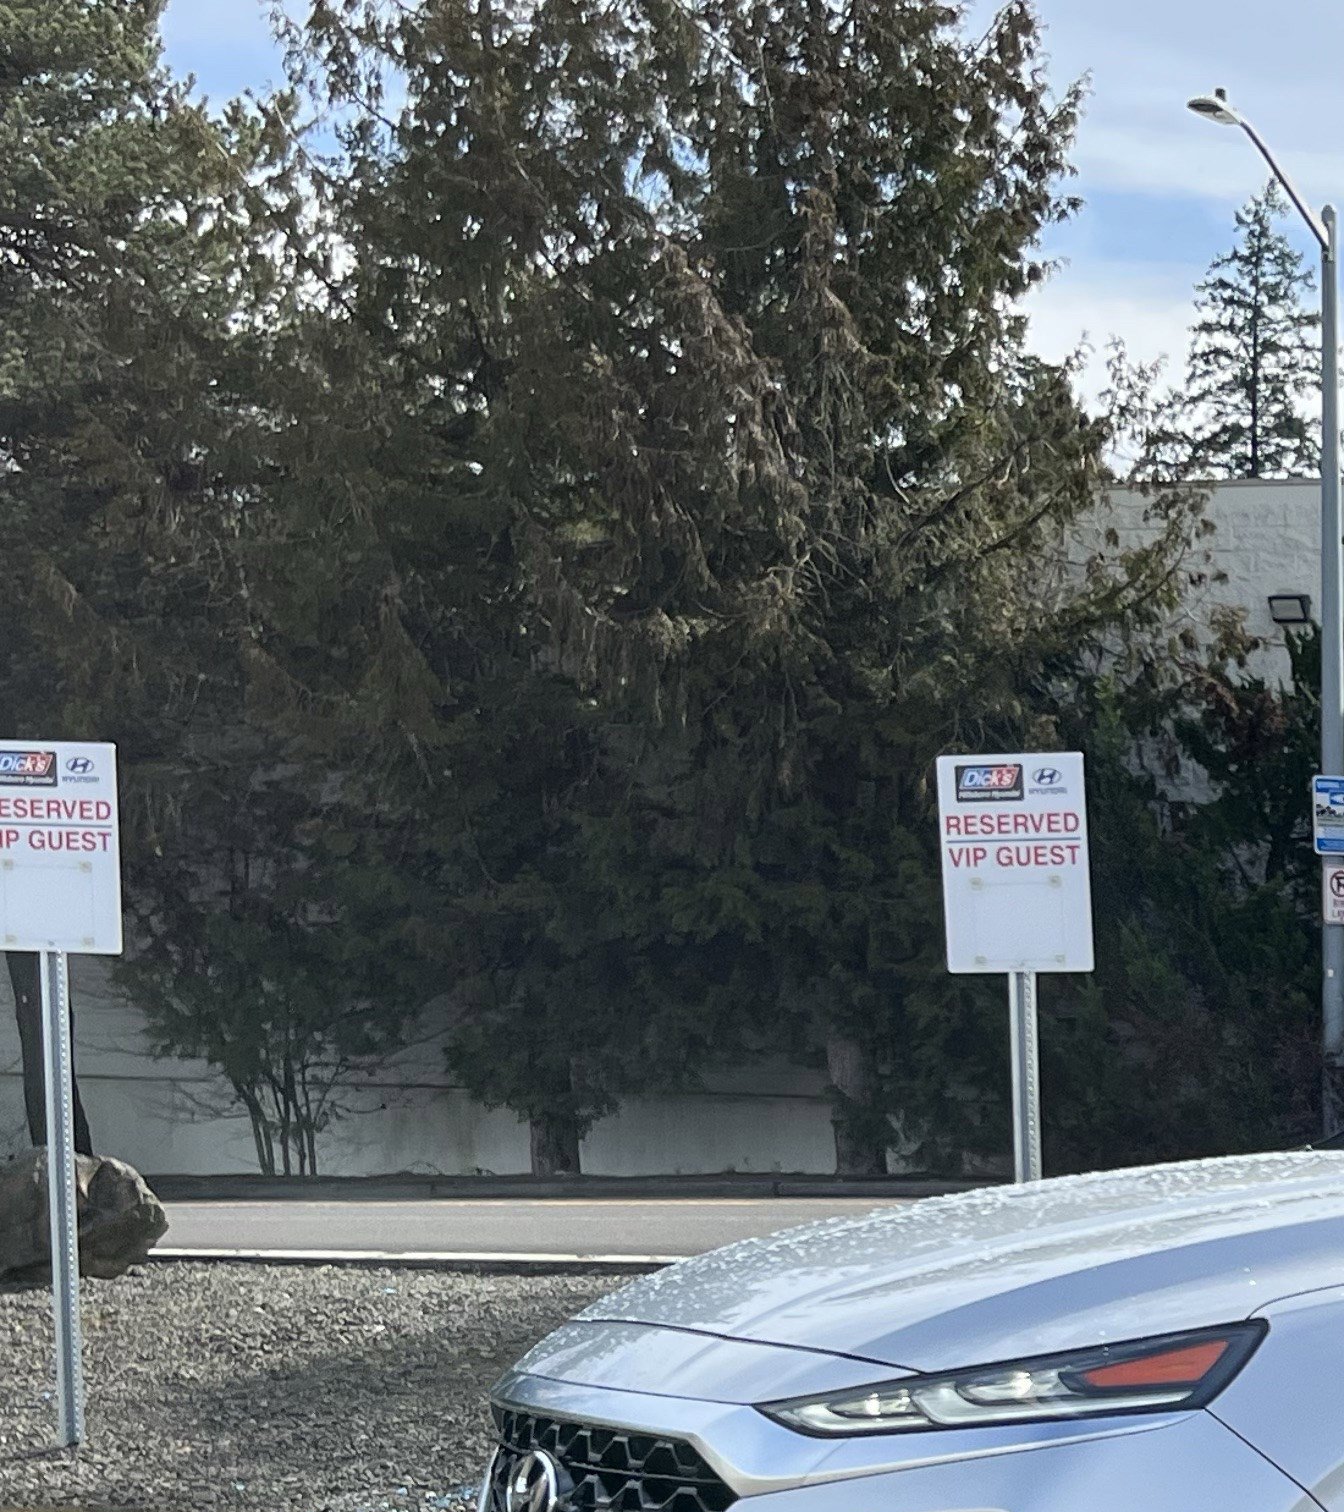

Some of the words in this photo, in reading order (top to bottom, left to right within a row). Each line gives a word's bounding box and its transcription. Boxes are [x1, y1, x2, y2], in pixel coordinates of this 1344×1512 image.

[945, 812, 1079, 836] RESERVED
[28, 830, 112, 852] GUEST
[949, 847, 987, 868] VIP
[996, 845, 1080, 867] GUEST
